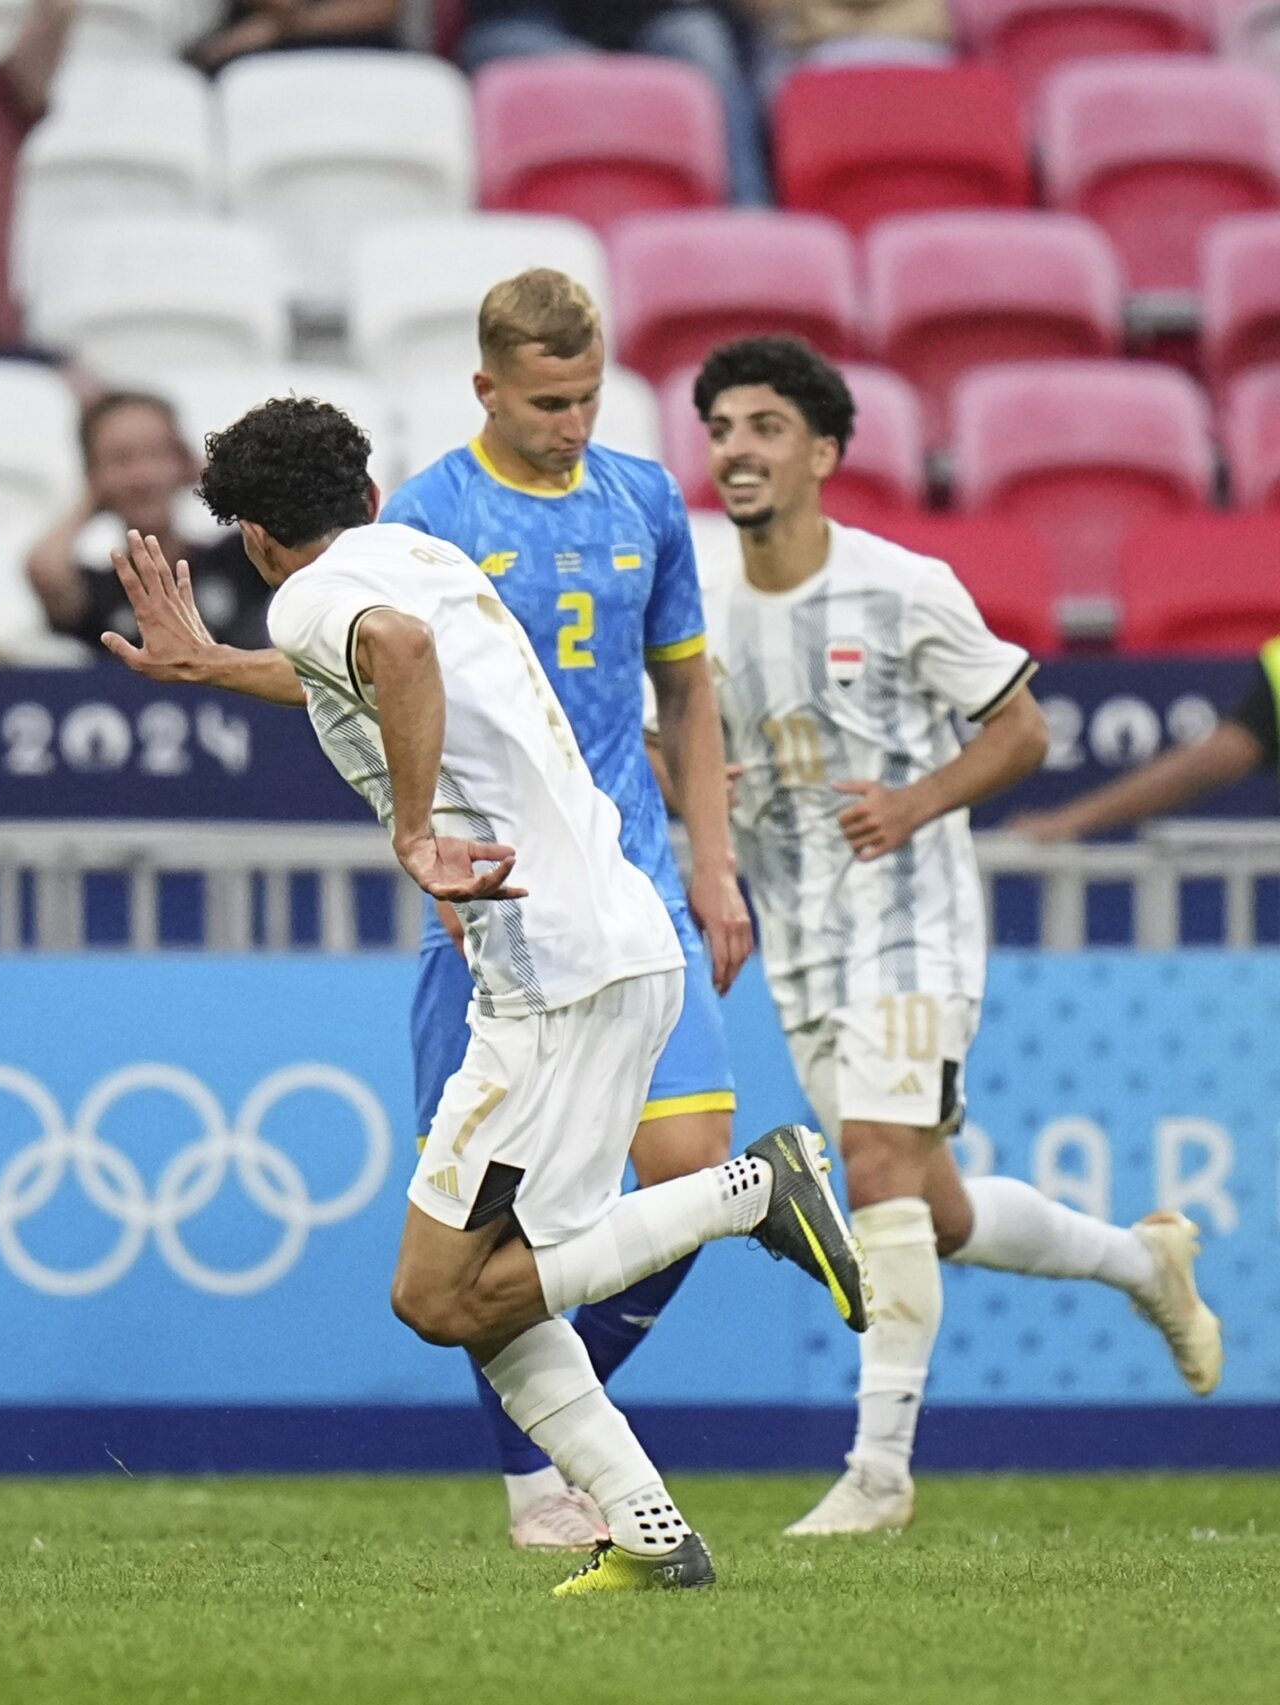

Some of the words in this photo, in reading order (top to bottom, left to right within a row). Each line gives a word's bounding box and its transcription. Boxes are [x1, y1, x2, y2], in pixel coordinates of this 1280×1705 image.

[556, 591, 596, 669] 2
[0, 701, 252, 776] 2024
[763, 712, 826, 786] 10
[877, 994, 940, 1061] 10
[452, 1080, 508, 1155] 7
